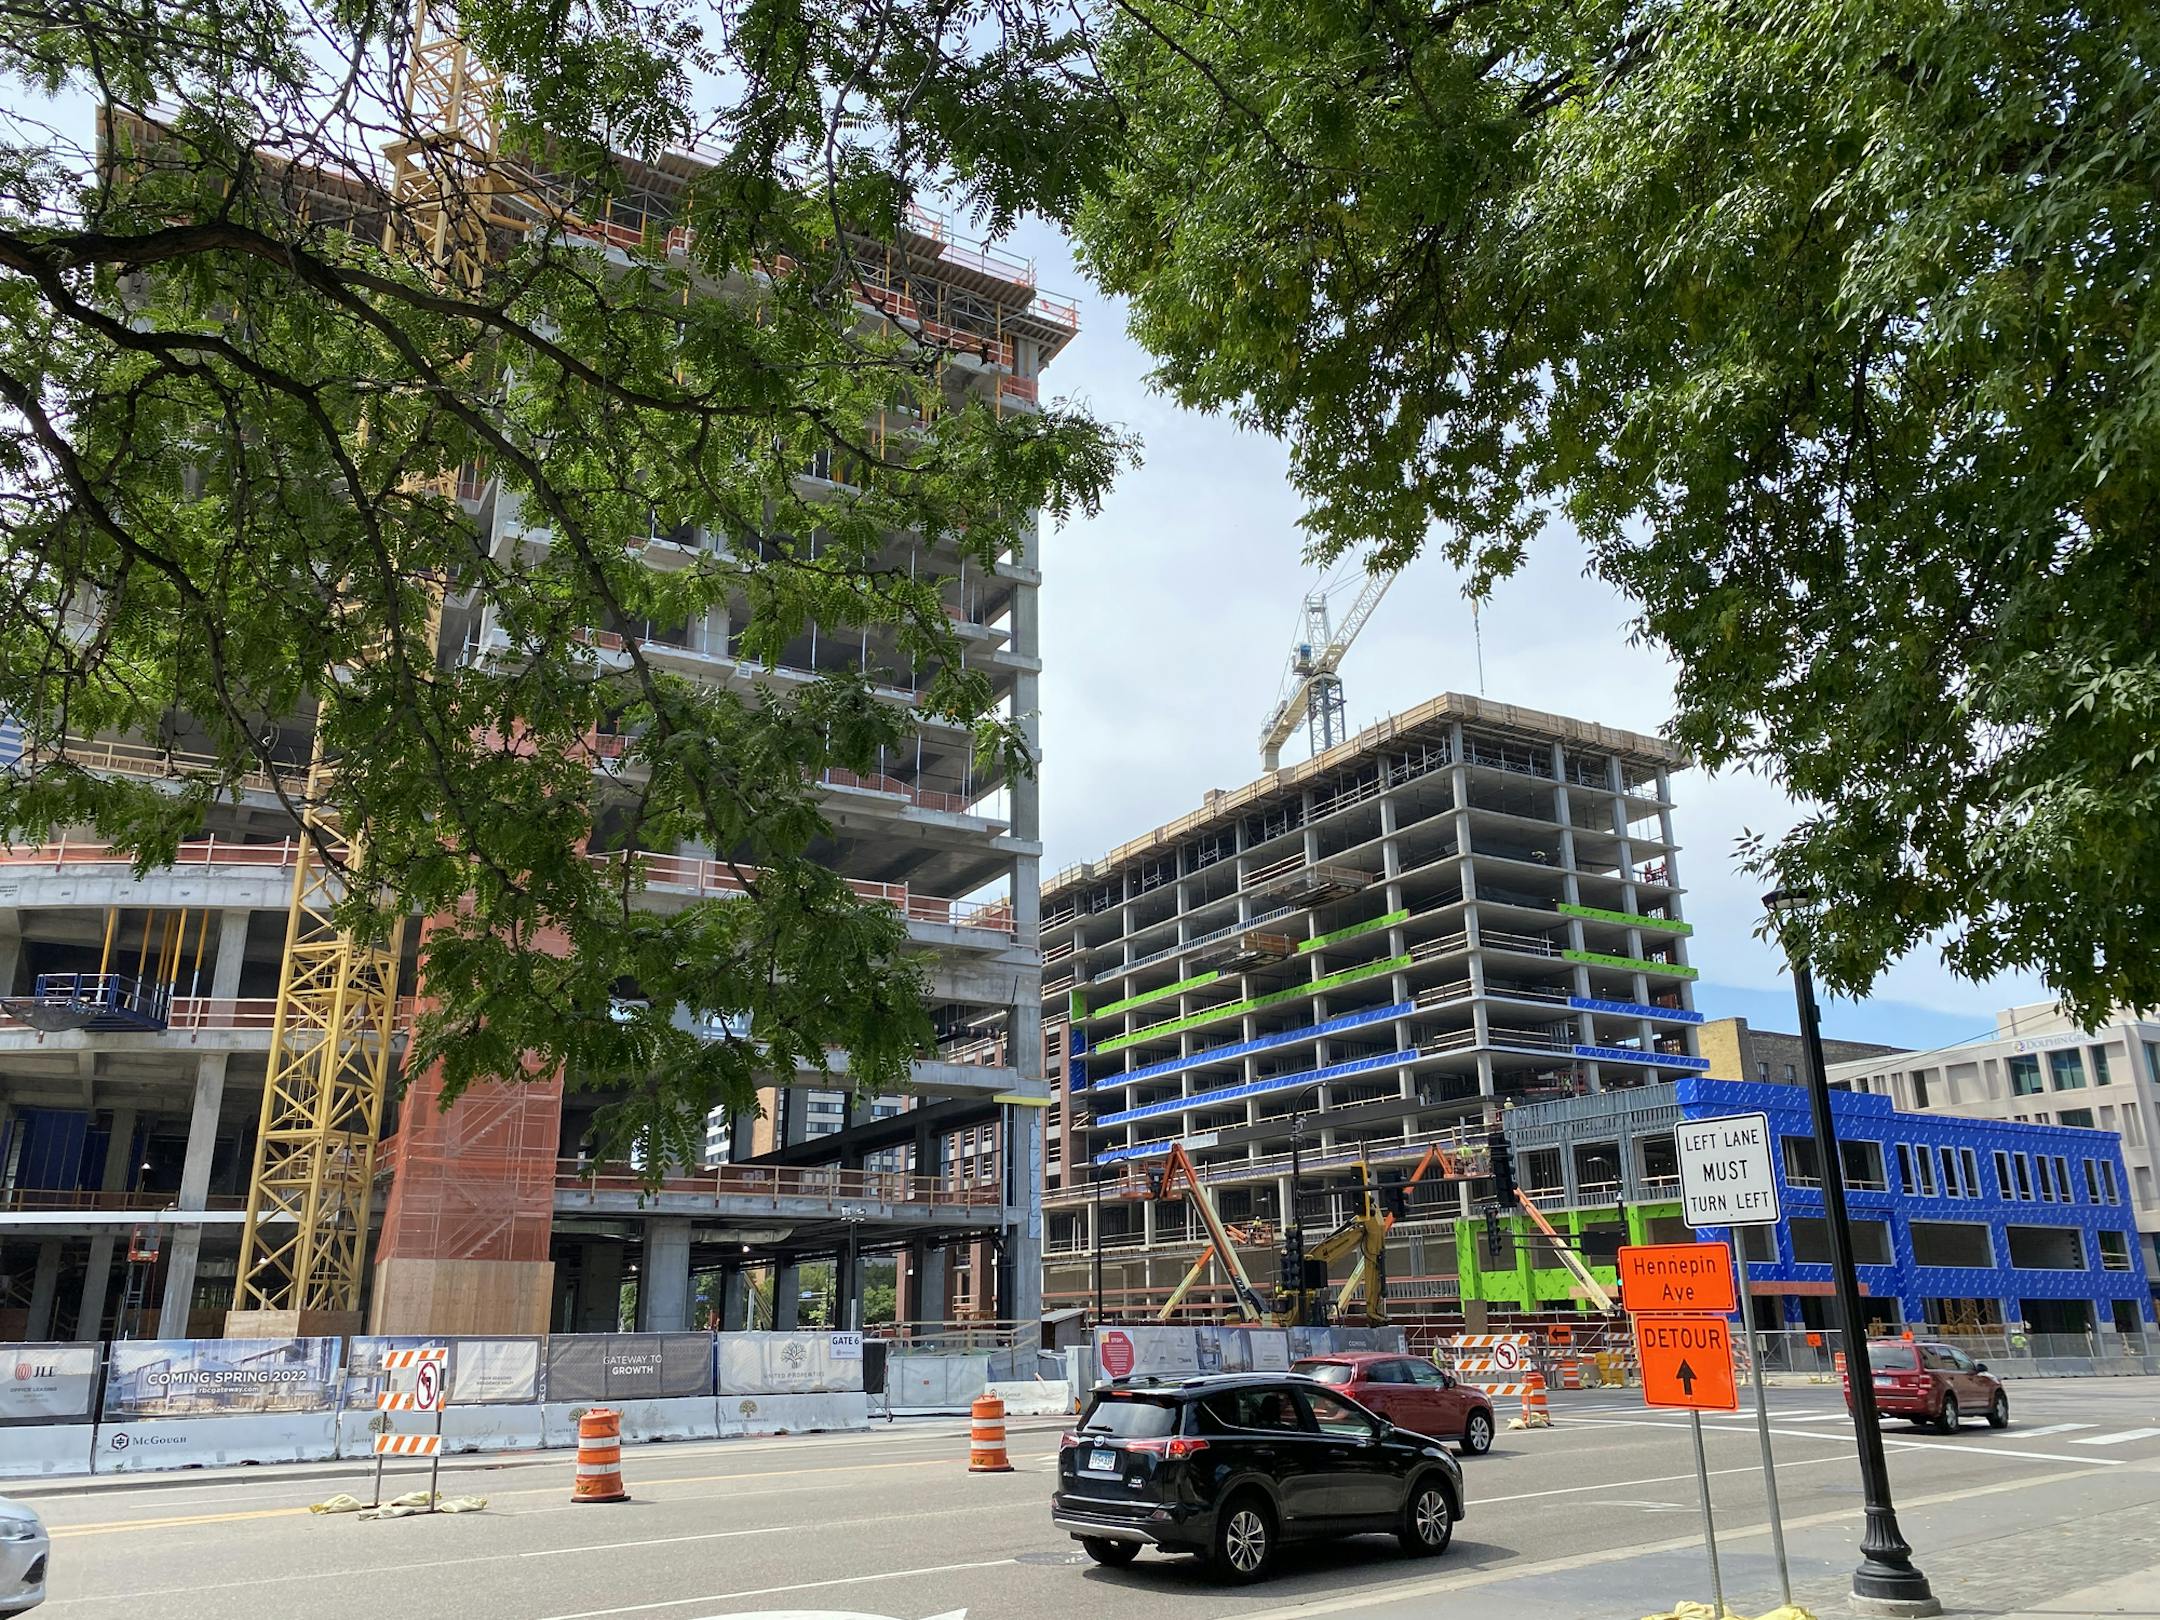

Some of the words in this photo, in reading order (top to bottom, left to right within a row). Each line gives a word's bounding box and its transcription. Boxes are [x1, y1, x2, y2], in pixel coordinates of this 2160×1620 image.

[2069, 1031, 2103, 1044] GROP
[1685, 1133, 1716, 1152] LEFT
[1724, 1129, 1759, 1148] LANE
[1702, 1159, 1748, 1182] MUST
[1690, 1194, 1727, 1213] TURN
[1736, 1191, 1769, 1209] LEFT
[1633, 1256, 1716, 1277] Hennepin
[1662, 1283, 1695, 1301] Ave
[832, 1336, 853, 1345] GATE
[854, 1336, 860, 1345] 6
[1644, 1328, 1722, 1350] DETOUR
[603, 1355, 648, 1365] GATEWAY
[650, 1354, 663, 1364] TO
[33, 1365, 57, 1378] JLL
[147, 1372, 210, 1385] COMING
[214, 1371, 268, 1383] SPRING
[271, 1370, 307, 1382] 2022
[611, 1365, 654, 1376] GROWTH
[199, 1385, 260, 1394] rbcgateway.com
